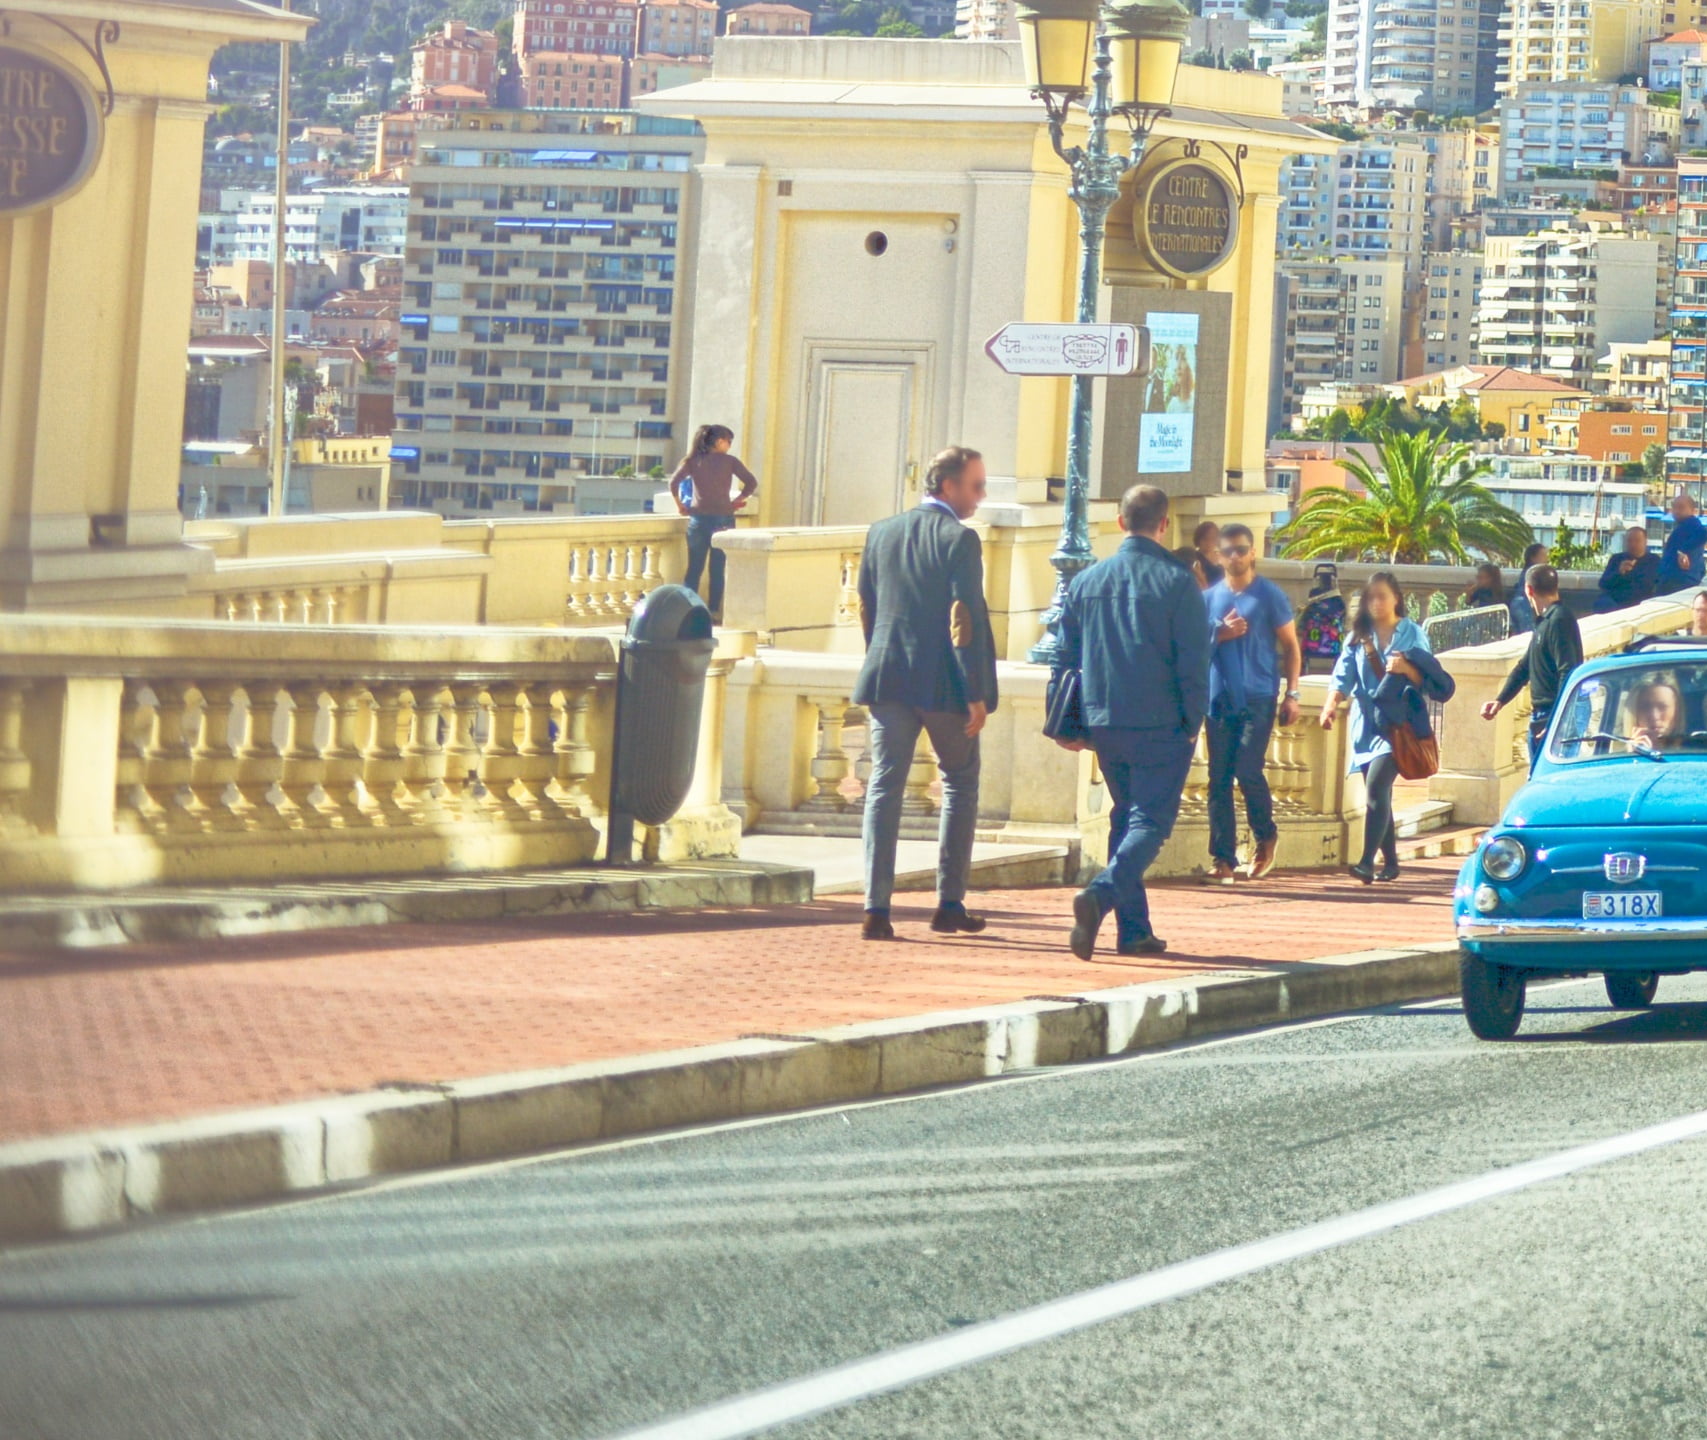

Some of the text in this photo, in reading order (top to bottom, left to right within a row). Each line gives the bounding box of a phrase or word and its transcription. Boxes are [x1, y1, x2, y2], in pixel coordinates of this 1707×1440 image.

[1168, 175, 1209, 199] CENTRE
[1163, 204, 1229, 229] RENCONTRES
[1150, 232, 1225, 254] NTERNATIONALES
[1604, 895, 1657, 916] 318X
